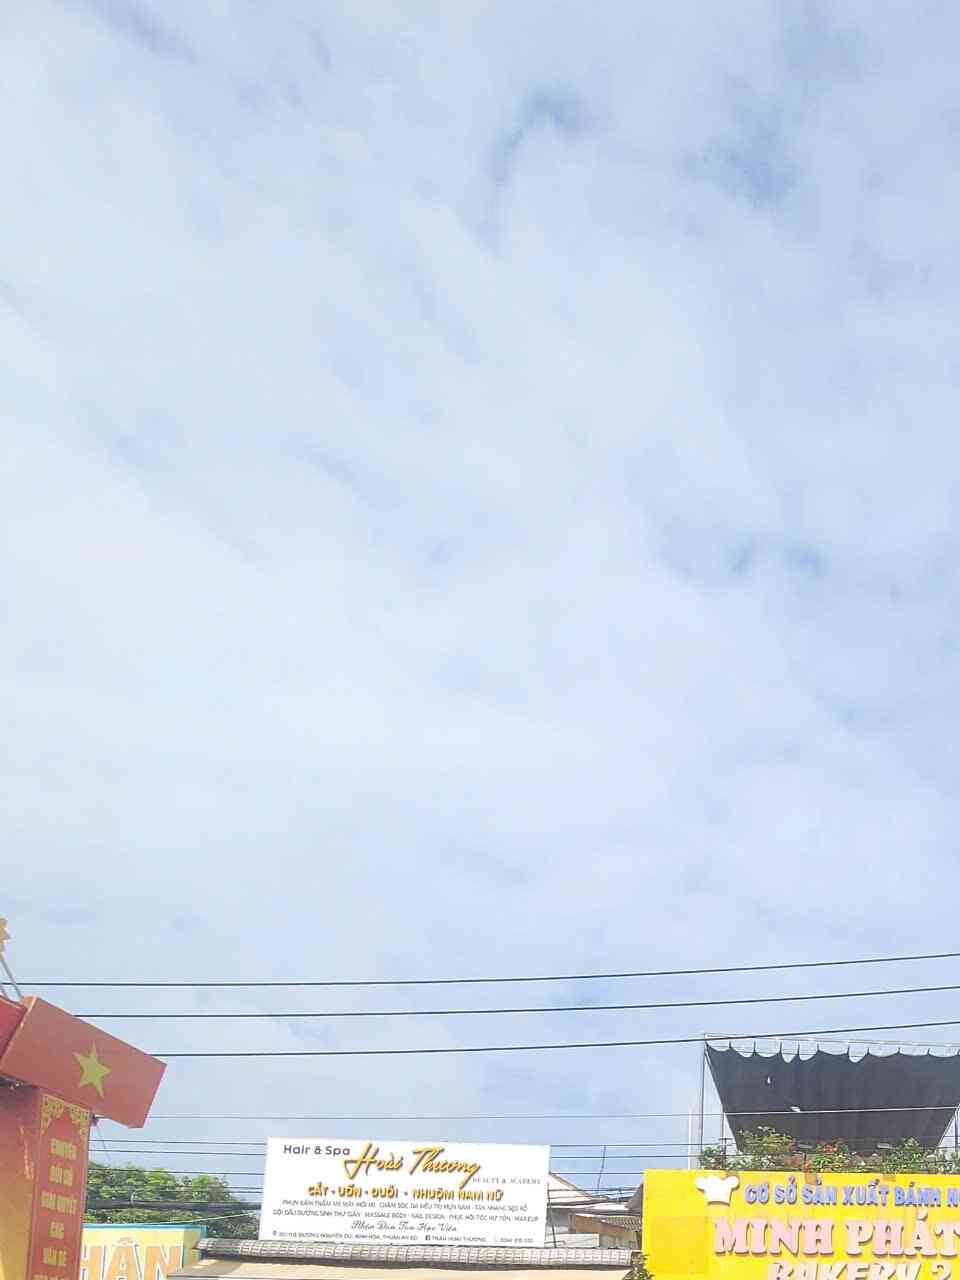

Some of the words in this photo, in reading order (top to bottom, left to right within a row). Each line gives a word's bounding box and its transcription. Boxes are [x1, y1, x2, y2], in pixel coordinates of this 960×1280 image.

[283, 1144, 311, 1155] Hair
[314, 1145, 322, 1155] &
[325, 1145, 351, 1157] Spa
[458, 1190, 484, 1201] NAM
[894, 1181, 942, 1208] BÁNH
[714, 1218, 834, 1257] MINH
